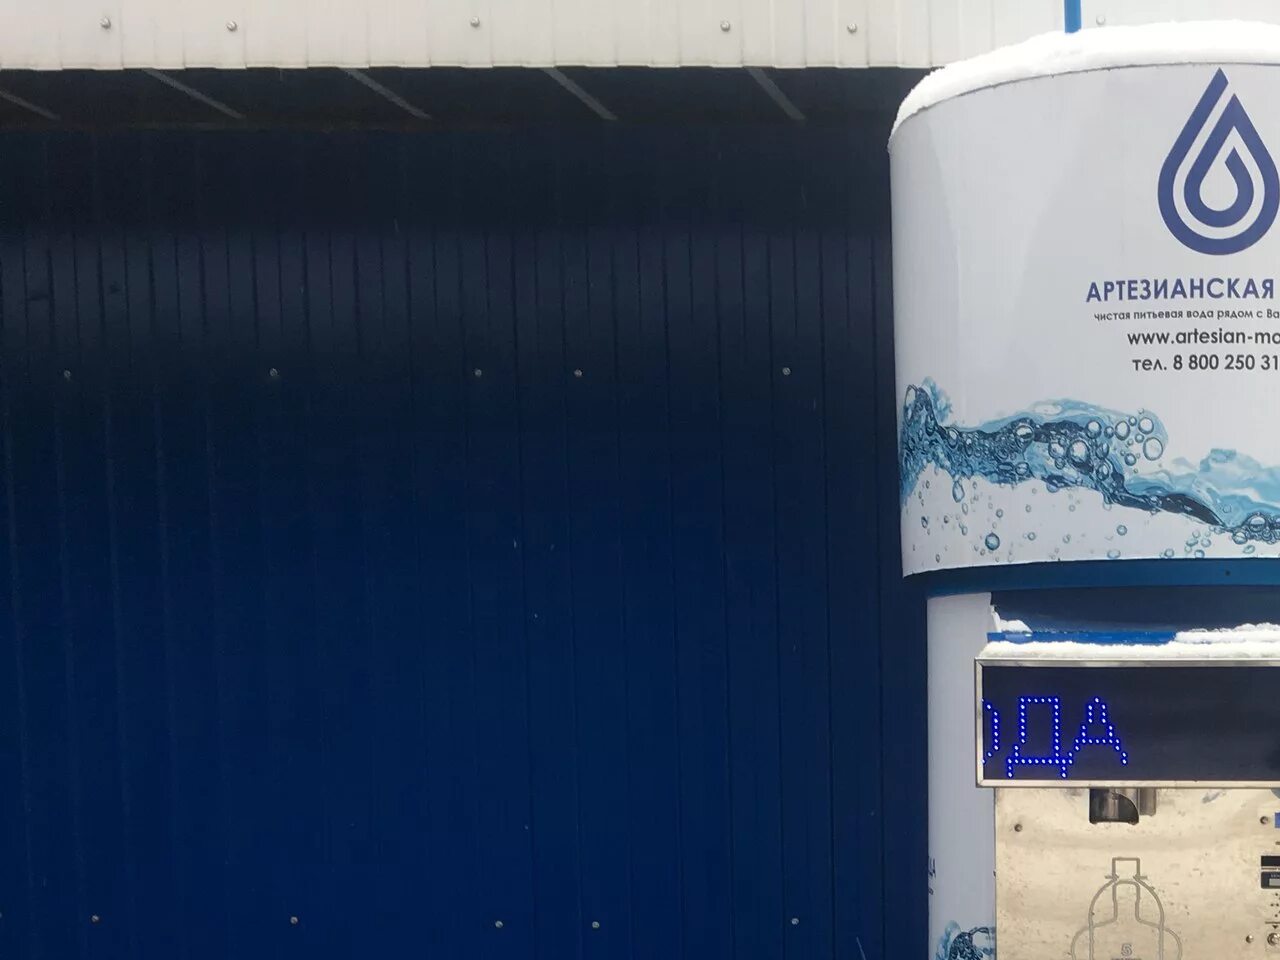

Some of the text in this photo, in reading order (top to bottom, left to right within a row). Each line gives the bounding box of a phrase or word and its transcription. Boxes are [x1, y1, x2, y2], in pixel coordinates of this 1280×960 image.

[1086, 277, 1274, 302] АРТЕЗИАНСКАЯ
[1094, 311, 1131, 321] чистая
[1133, 310, 1183, 320] питьевая
[1187, 310, 1214, 319] вода
[1217, 310, 1254, 320] рядом
[1132, 359, 1168, 371] тел.
[1172, 354, 1183, 370] 8
[1188, 354, 1219, 370] 800
[1224, 354, 1255, 370] 250
[1260, 355, 1279, 370] 31
[1121, 943, 1133, 956] 5
